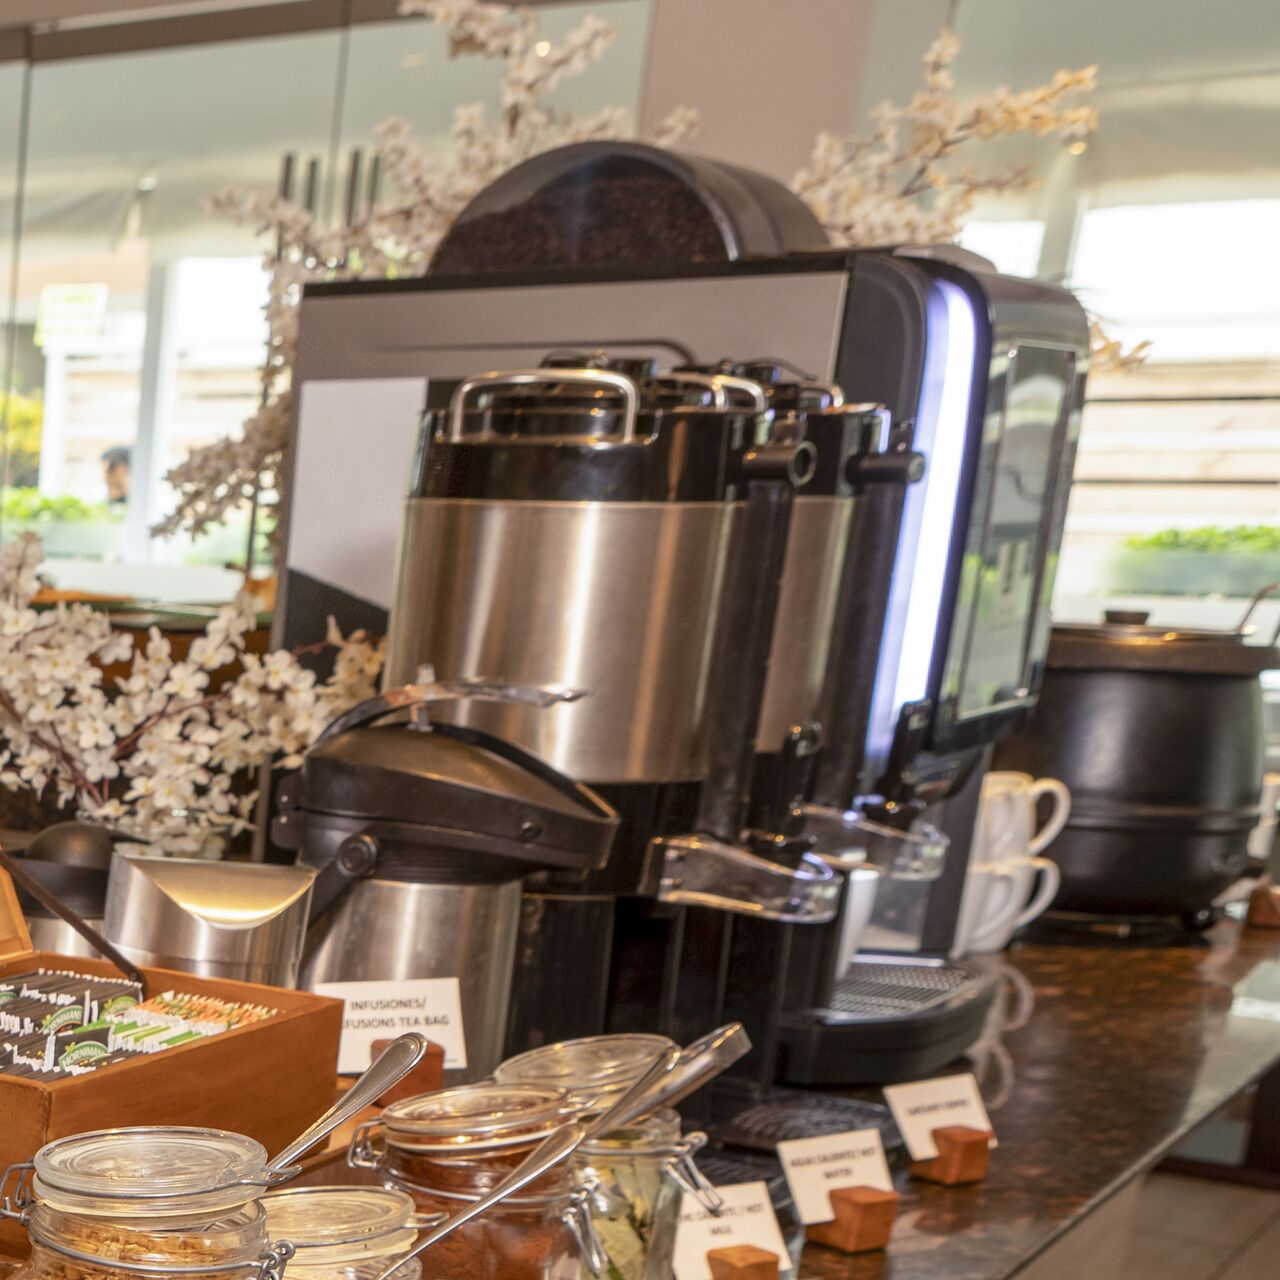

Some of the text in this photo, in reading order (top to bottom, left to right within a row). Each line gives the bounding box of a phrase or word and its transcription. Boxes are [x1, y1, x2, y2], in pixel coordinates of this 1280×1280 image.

[351, 997, 428, 1010] INFUSIONES/
[342, 1014, 449, 1028] FUSIONS TEA BAG
